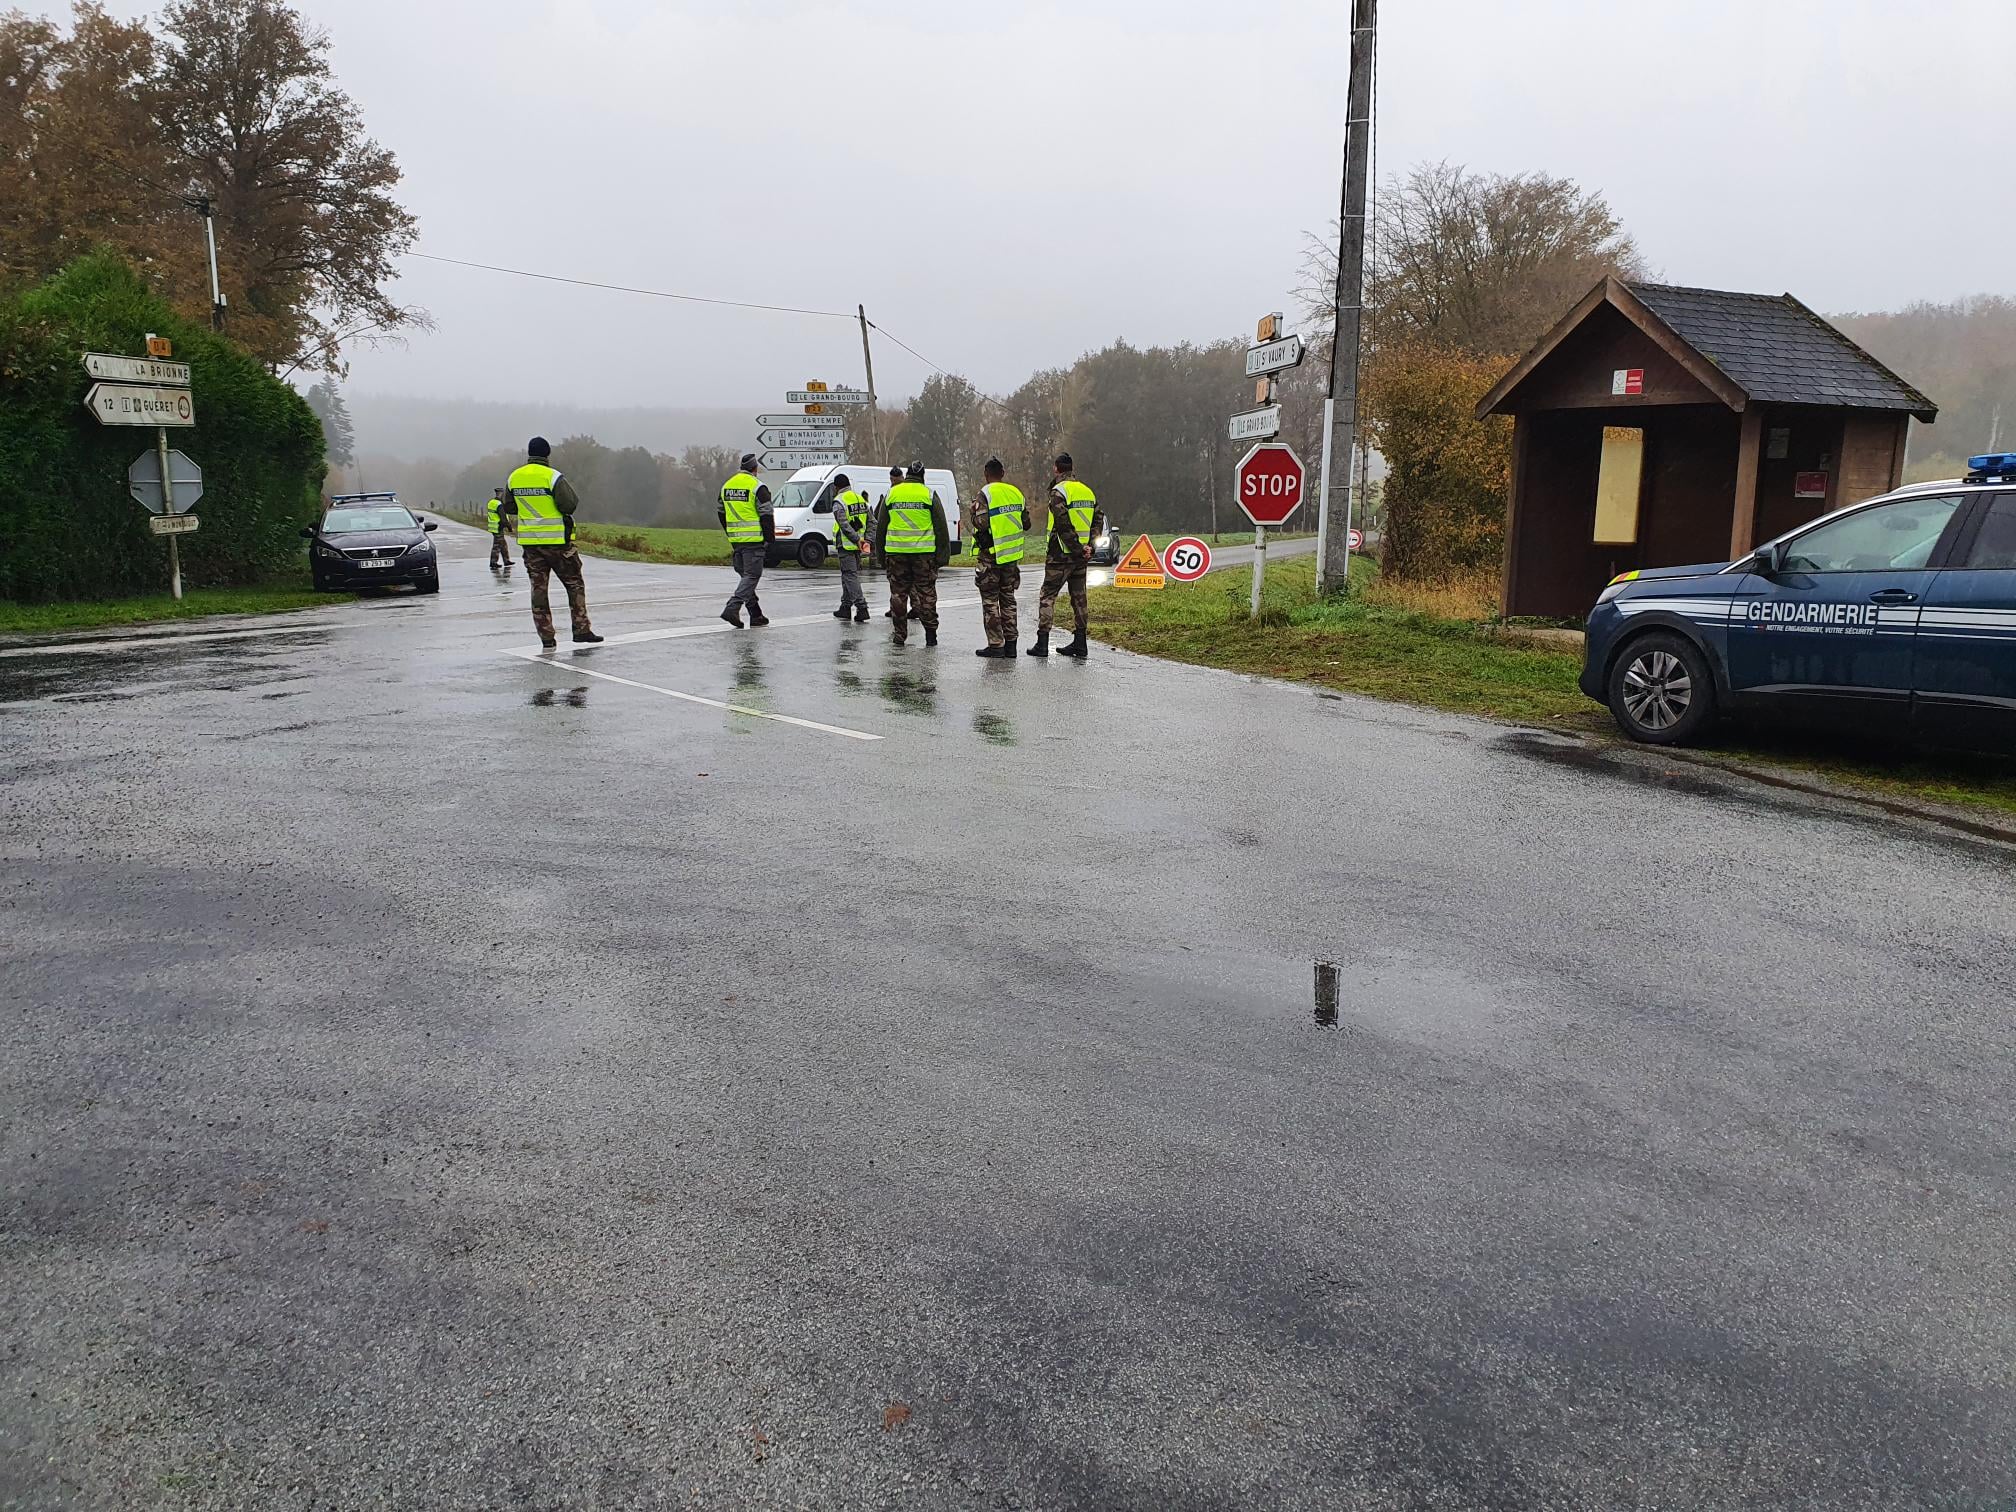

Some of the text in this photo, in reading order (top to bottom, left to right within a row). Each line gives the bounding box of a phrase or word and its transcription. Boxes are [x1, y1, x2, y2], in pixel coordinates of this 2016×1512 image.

[1268, 346, 1286, 364] VAURY
[93, 360, 189, 380] 4 LA BRIONNE
[103, 398, 114, 410] 12
[1244, 473, 1297, 496] STOP
[1173, 548, 1202, 570] 50
[1116, 577, 1163, 585] GRAVILLONS
[1748, 601, 1878, 626] GENDARMERIE
[1765, 624, 1785, 632] NOTRE
[1844, 626, 1875, 636] SÉCURITÉ
